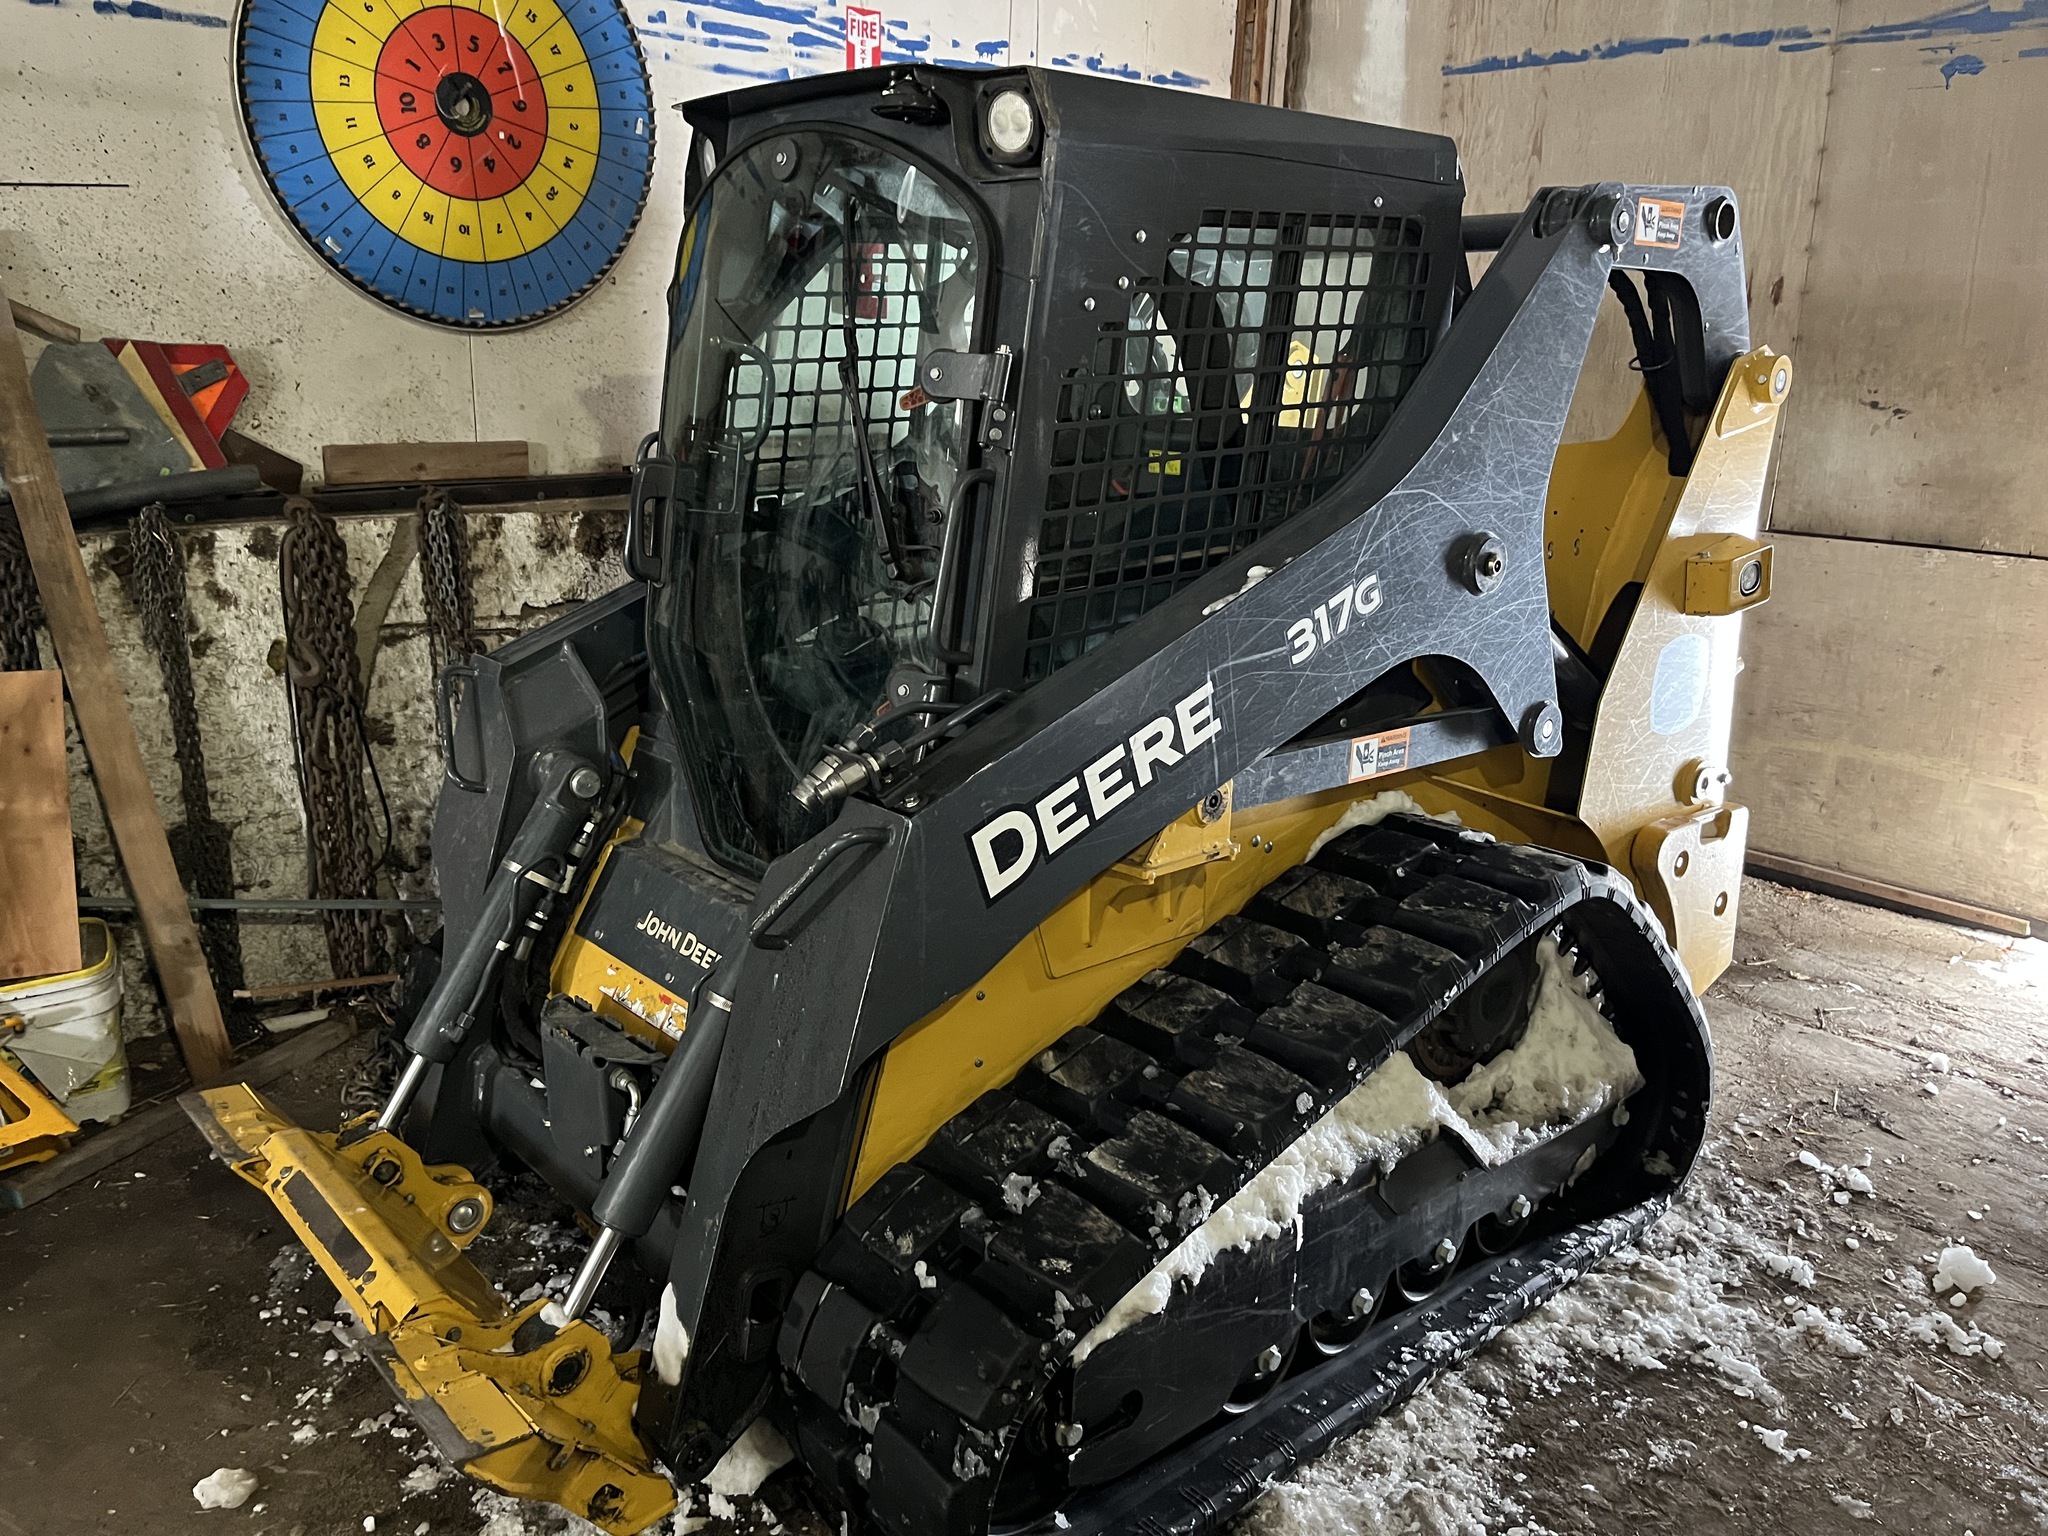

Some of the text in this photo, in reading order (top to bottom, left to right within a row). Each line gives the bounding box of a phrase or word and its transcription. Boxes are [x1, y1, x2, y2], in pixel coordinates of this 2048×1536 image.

[364, 2, 374, 12] 6
[525, 9, 537, 23] 15
[850, 18, 877, 39] FIRE
[346, 37, 356, 45] 1
[432, 33, 445, 51] 3
[468, 35, 480, 52] 5
[550, 44, 561, 55] 17
[405, 58, 421, 72] 1
[497, 61, 513, 74] 7
[340, 74, 350, 87] 13
[565, 84, 574, 92] 9
[400, 92, 416, 113] 10
[513, 99, 527, 112] 9
[346, 117, 357, 129] 11
[570, 123, 578, 131] 2
[416, 134, 430, 149] 8
[507, 134, 521, 150] 2
[363, 154, 376, 169] 18
[450, 157, 462, 173] 6
[484, 156, 495, 173] 4
[563, 156, 574, 169] 14
[392, 190, 401, 200] 8
[546, 186, 559, 201] 20
[423, 212, 434, 224] 16
[525, 212, 532, 221] 4
[459, 224, 470, 235] 10
[496, 223, 503, 234] 7
[1286, 574, 1382, 665] 317G
[971, 682, 1222, 899] DEERE
[636, 910, 722, 970] JOHN DEE
